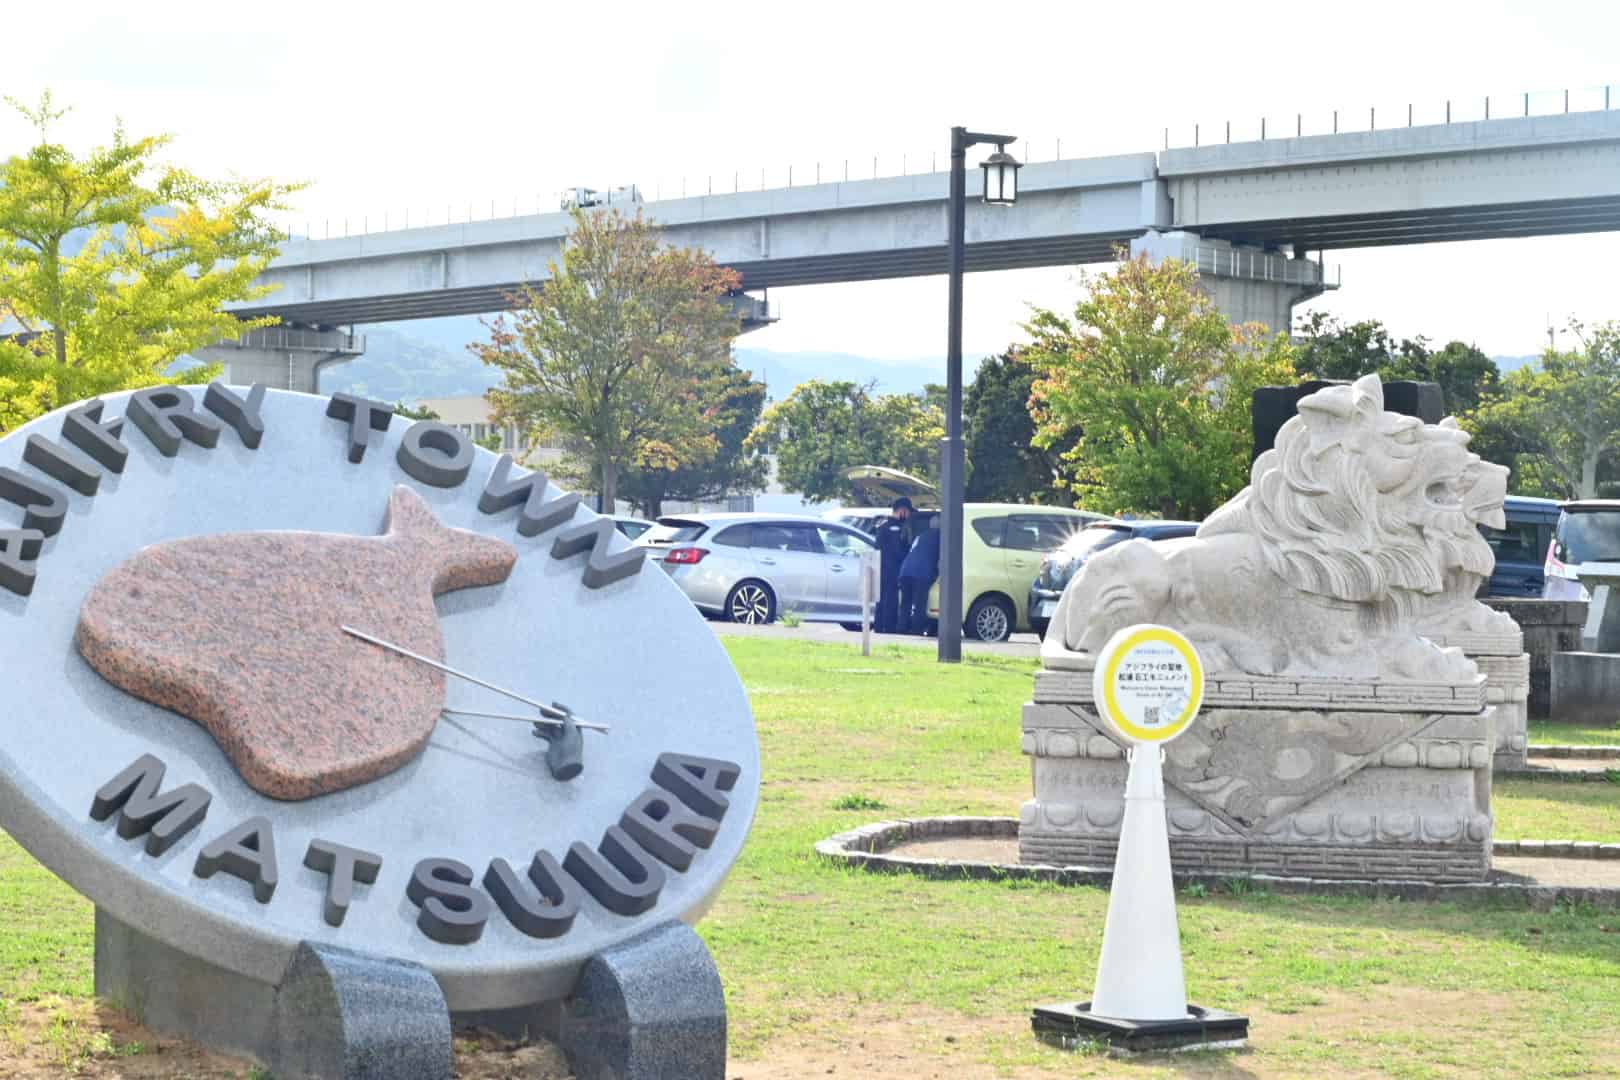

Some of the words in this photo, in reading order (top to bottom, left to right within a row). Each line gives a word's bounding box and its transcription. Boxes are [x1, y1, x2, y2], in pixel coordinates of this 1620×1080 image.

[0, 381, 267, 597] AJIFRY
[326, 392, 647, 589] TOWN
[89, 752, 741, 945] MATSUURA
